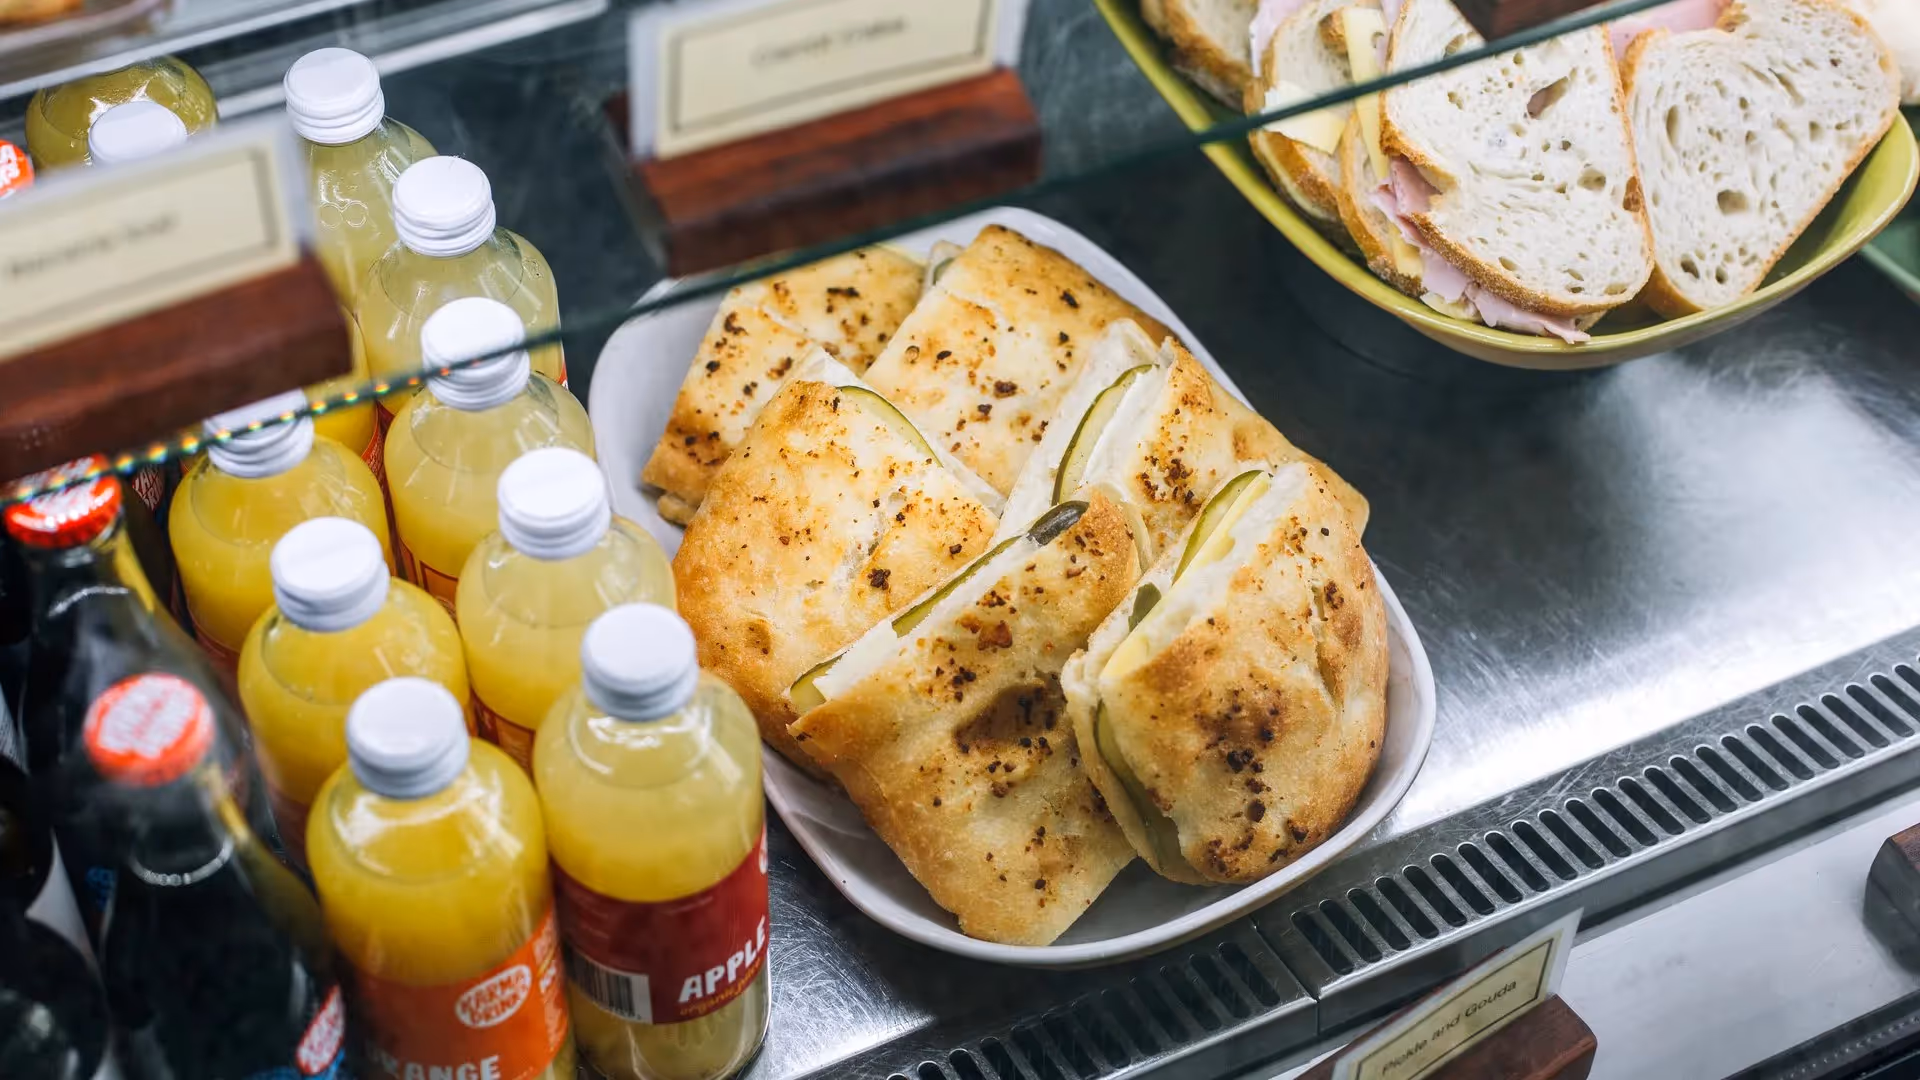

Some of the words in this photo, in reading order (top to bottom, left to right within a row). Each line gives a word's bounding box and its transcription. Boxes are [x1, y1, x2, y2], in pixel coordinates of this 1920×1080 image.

[678, 914, 766, 1004] APPLE
[1382, 1039, 1428, 1076] Pickle
[1432, 1013, 1461, 1041] and
[1465, 980, 1517, 1018] Gouda
